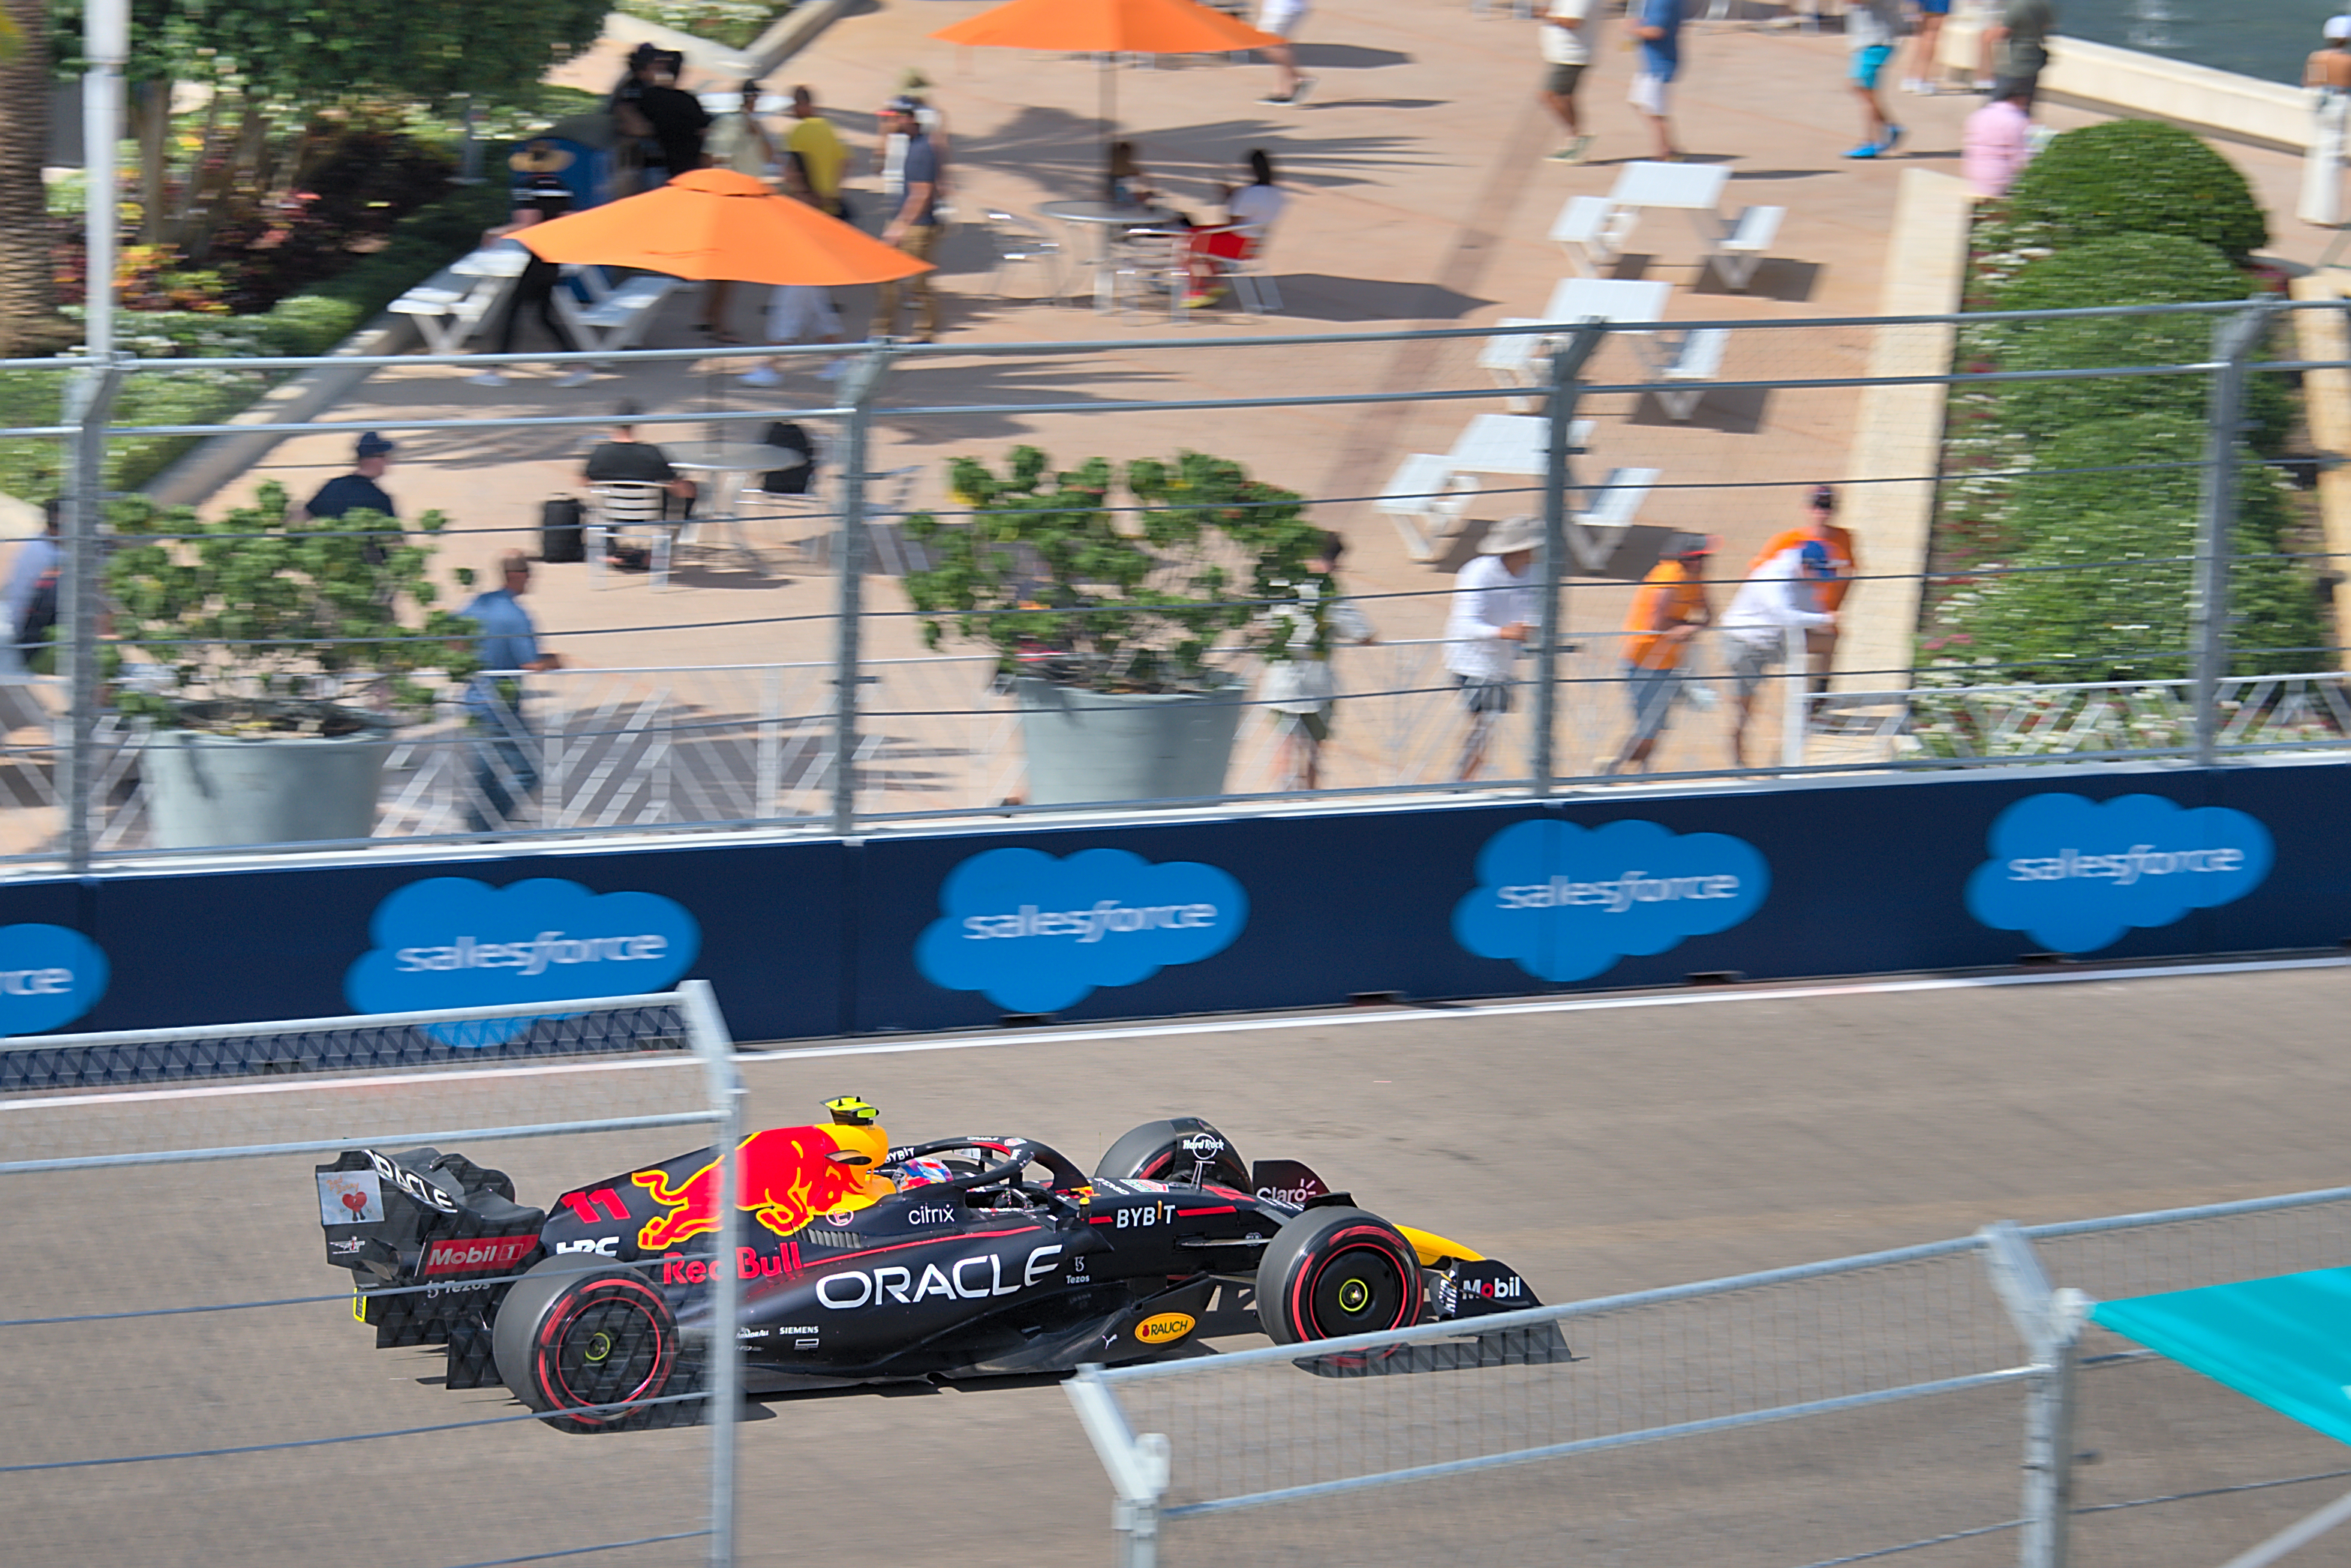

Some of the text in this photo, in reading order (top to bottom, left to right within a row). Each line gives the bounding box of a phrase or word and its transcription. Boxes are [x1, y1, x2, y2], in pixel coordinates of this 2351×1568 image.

[2007, 845, 2245, 885] salesforce
[1496, 870, 1740, 912] salesforce
[958, 900, 1218, 943] salesforce
[395, 931, 668, 975] salesforce
[1183, 1139, 1224, 1151] Hard Rock
[560, 1188, 631, 1224] 11
[1256, 1187, 1307, 1203] Claro
[908, 1202, 955, 1224] citrix
[1117, 1200, 1176, 1228] BYBIT
[428, 1246, 498, 1266] Mobil
[735, 1241, 803, 1279] Bull
[816, 1244, 1063, 1309] ORACLE
[1066, 1275, 1090, 1284] Tezos
[1463, 1276, 1520, 1299] Mobil
[780, 1326, 819, 1335] SIEMENS
[1151, 1320, 1188, 1336] RAUCH
